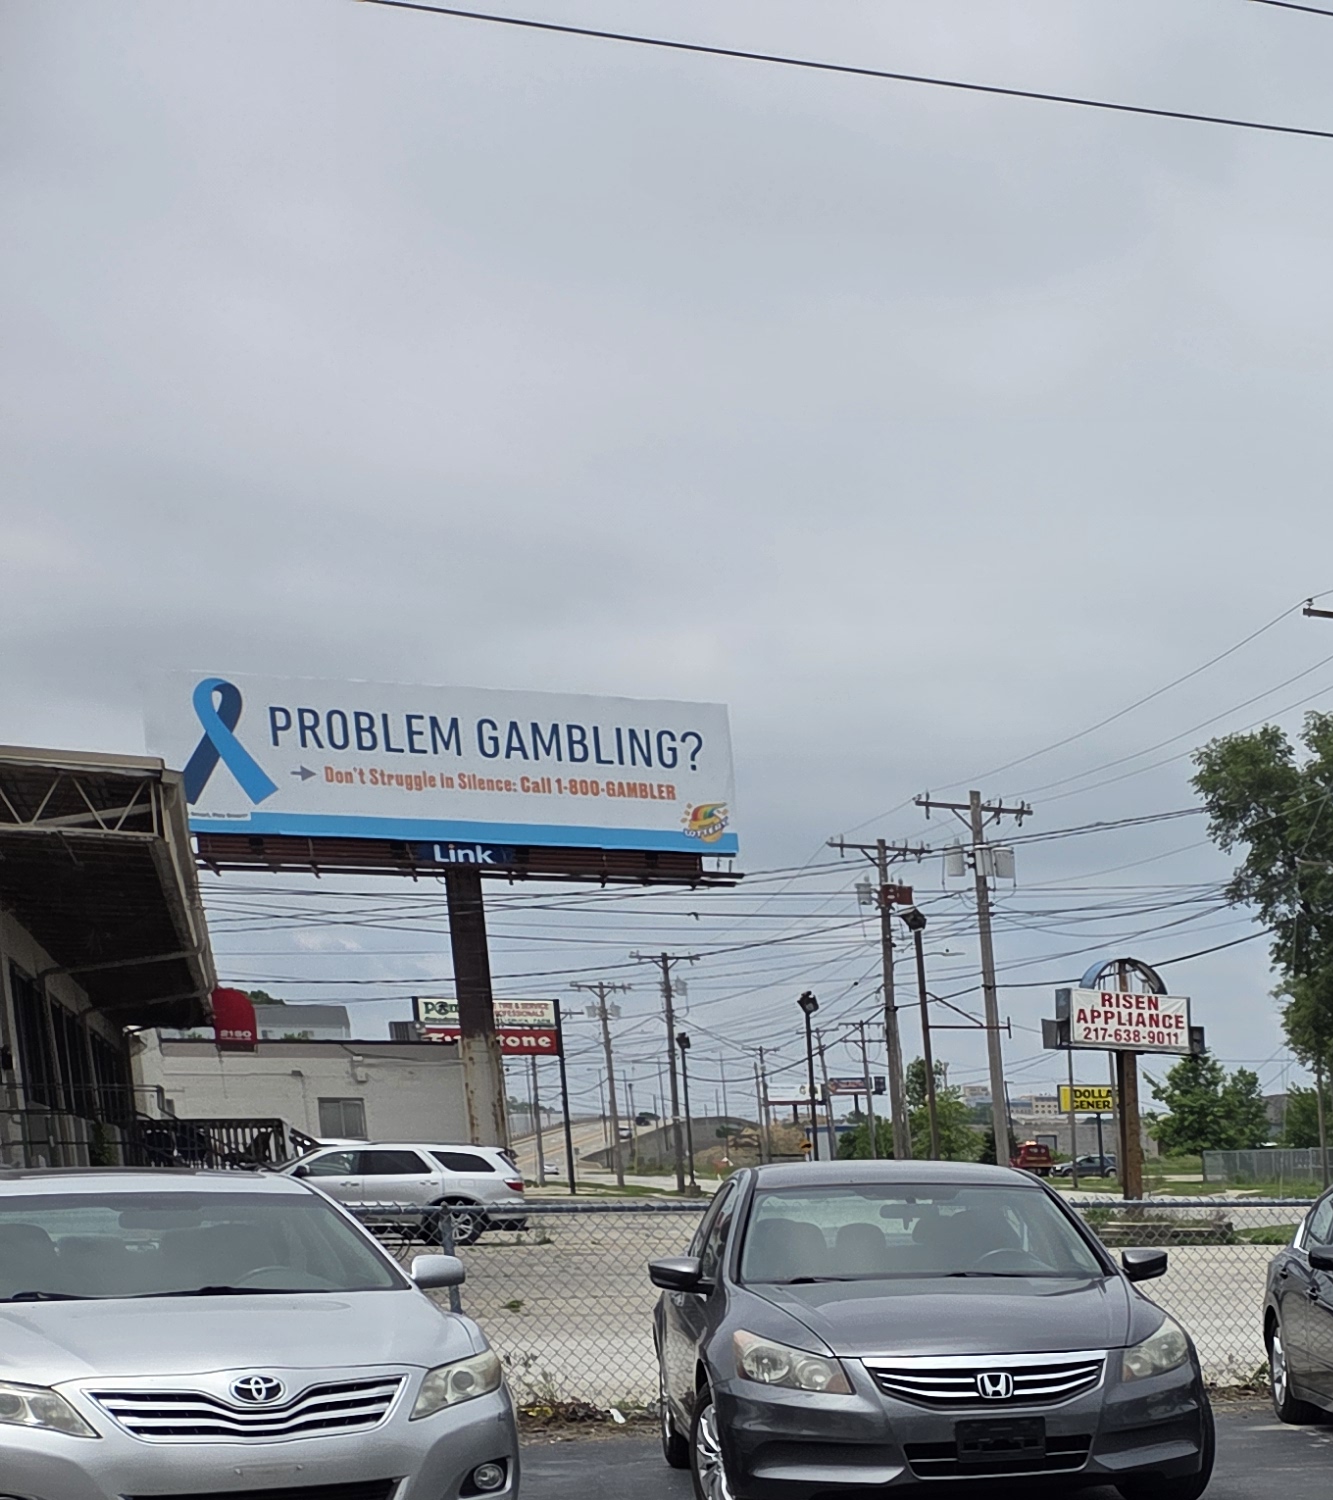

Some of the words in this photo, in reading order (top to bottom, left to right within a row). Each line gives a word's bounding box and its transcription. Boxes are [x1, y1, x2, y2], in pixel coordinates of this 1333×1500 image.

[269, 705, 462, 757] PROBLEM
[476, 717, 703, 772] GAMBLING?
[324, 765, 366, 785] Don't
[369, 767, 437, 792] Struggle
[440, 772, 455, 789] in
[458, 772, 518, 793] Silence:
[520, 775, 552, 795] Call
[554, 777, 677, 801] 1-800-GAMBLER
[433, 843, 497, 865] Link
[1100, 992, 1159, 1012] RISEN
[1076, 1009, 1185, 1030] APPLIANCE
[1083, 1026, 1179, 1046] 217-638-9011
[1074, 1088, 1122, 1099] DOLLA
[1074, 1099, 1112, 1110] GENER
